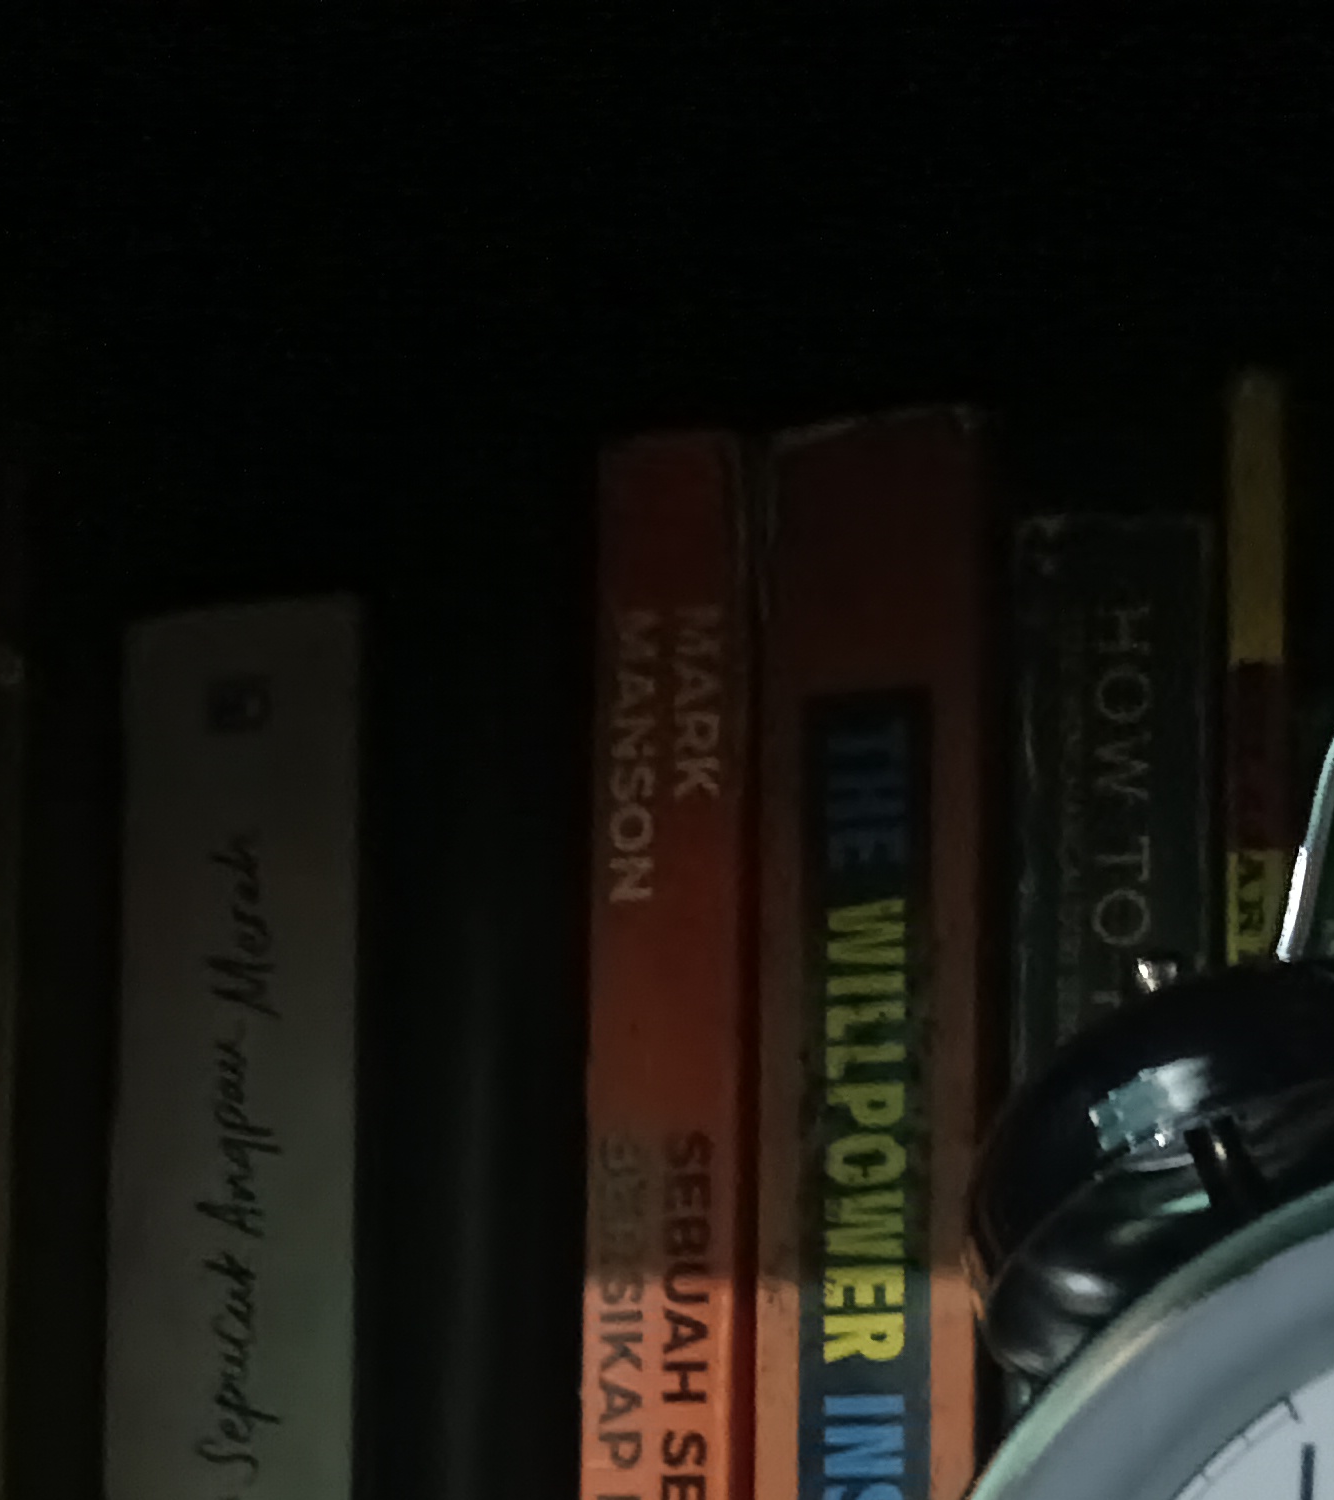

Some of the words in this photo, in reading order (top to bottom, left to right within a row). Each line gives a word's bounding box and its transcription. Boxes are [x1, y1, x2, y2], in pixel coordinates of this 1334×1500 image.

[609, 607, 657, 904] MANSON
[671, 604, 721, 800] MARK
[825, 714, 910, 874] THE
[1094, 605, 1152, 802] HOW
[1092, 835, 1151, 947] TO
[823, 897, 907, 1364] WILLPOWER
[661, 1130, 714, 1406] SEBUAH
